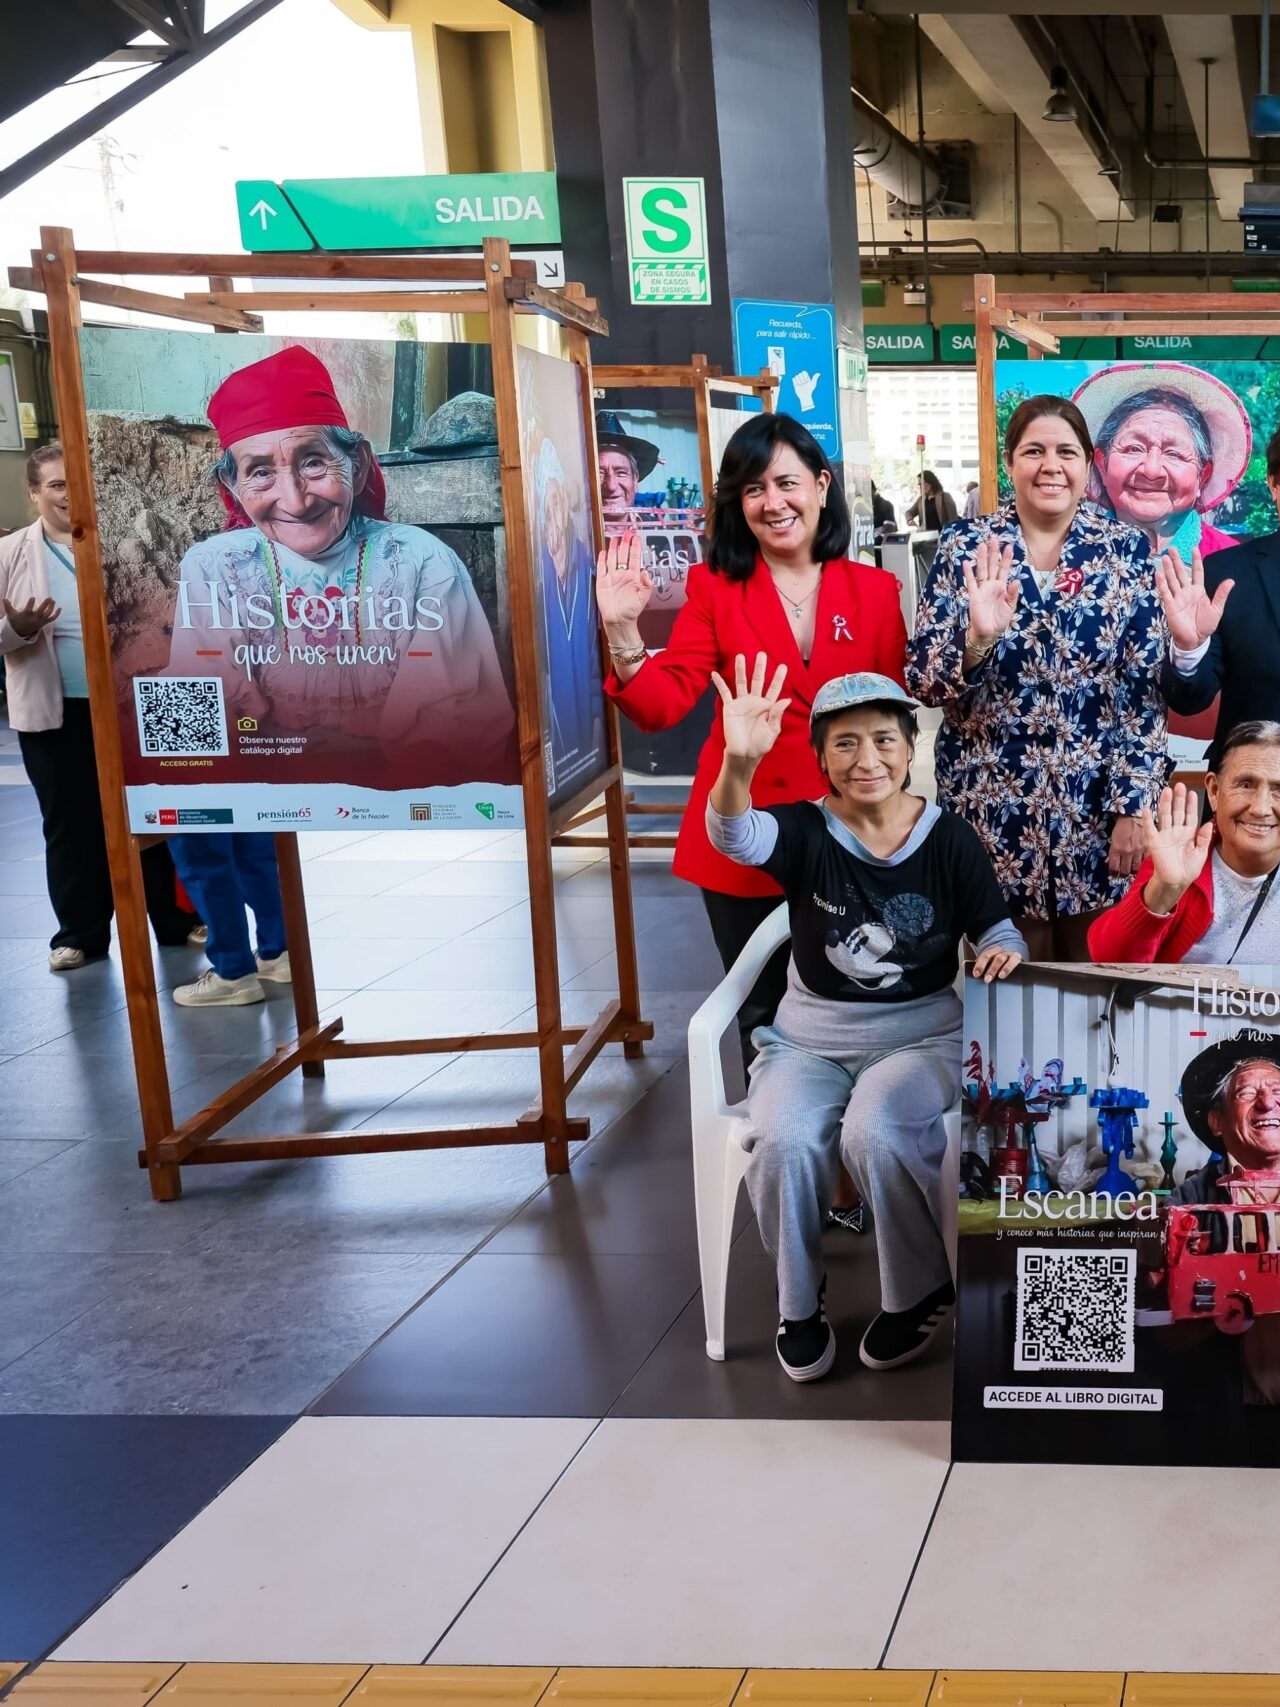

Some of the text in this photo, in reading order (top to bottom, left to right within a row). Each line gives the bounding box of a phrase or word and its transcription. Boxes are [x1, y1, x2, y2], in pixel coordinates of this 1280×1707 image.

[435, 196, 545, 224] SALIDA
[641, 187, 691, 253] S
[756, 330, 772, 338] para
[773, 330, 788, 338] salir
[866, 335, 925, 349] SALIDA
[1134, 336, 1192, 348] SALIDA
[174, 578, 444, 632] Historias
[234, 642, 397, 682] que nos unen
[238, 736, 307, 744] Observa nuestro
[240, 745, 302, 756] catálogo digital
[838, 906, 846, 916] U
[1213, 1030, 1242, 1050] que
[1248, 1030, 1274, 1042] nos
[996, 1175, 1160, 1220] Escanea
[996, 1230, 1004, 1240] y
[1036, 1228, 1054, 1238] más
[1057, 1228, 1095, 1238] historias
[1098, 1230, 1115, 1242] que
[1117, 1230, 1159, 1243] inspiran
[989, 1391, 1158, 1404] ACCEDE AL LIBRO DIGITAL
